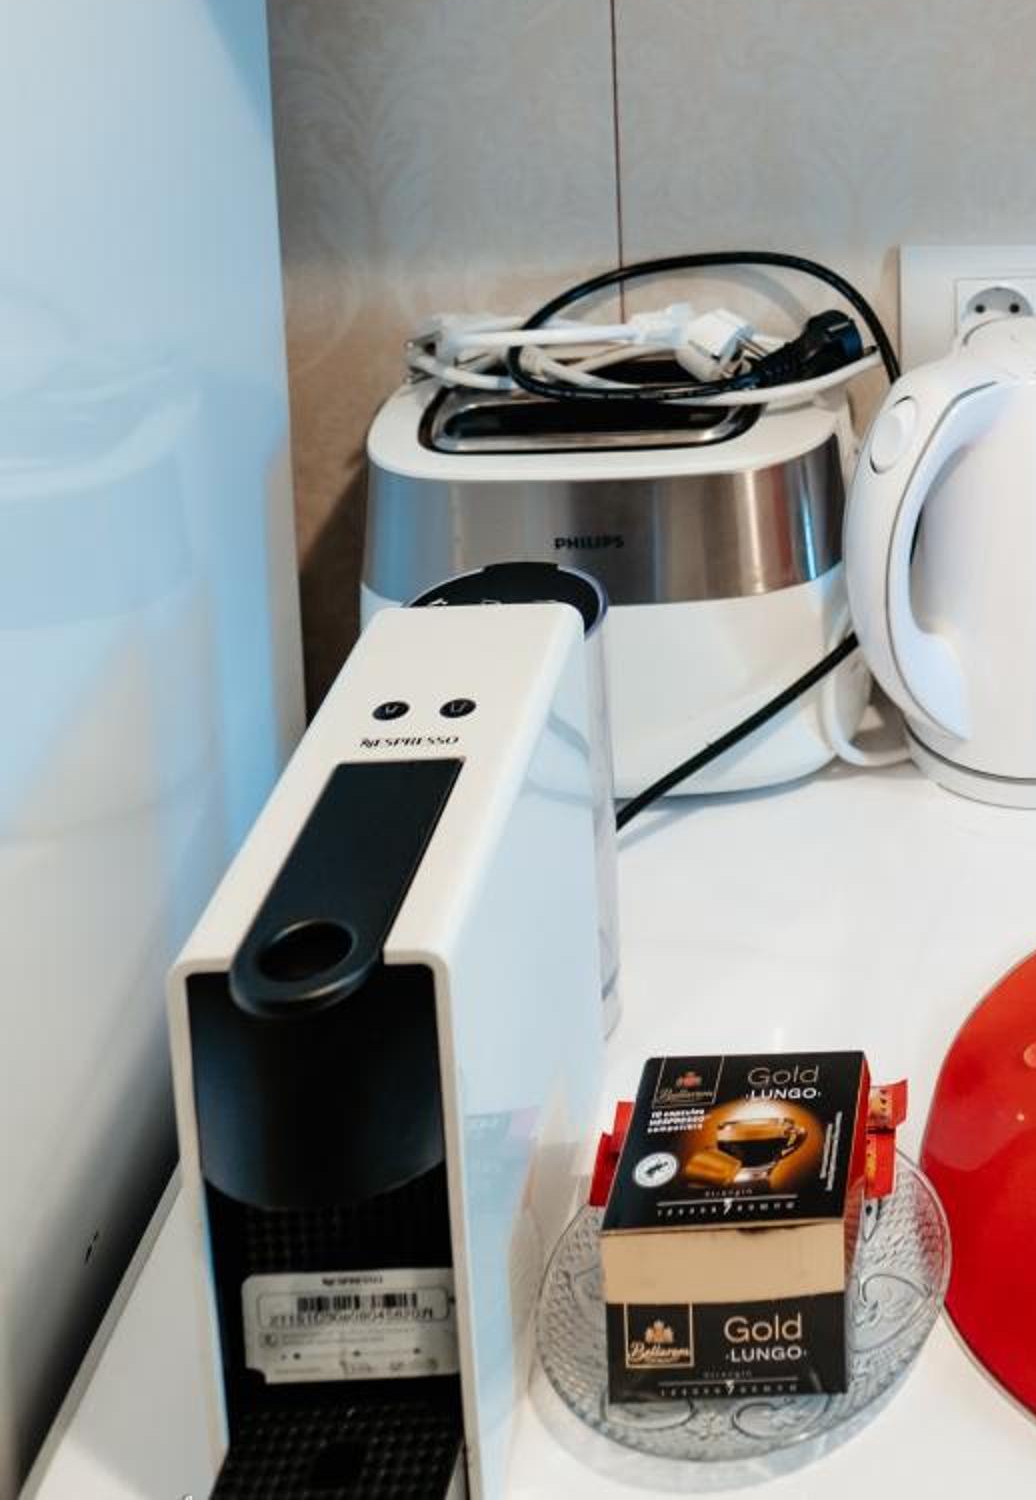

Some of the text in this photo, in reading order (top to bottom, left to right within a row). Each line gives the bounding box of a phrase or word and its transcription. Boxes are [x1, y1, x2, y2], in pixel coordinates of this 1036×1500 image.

[554, 535, 625, 550] PHILIPS
[747, 1064, 820, 1086] Gold
[723, 1312, 803, 1343] Gold
